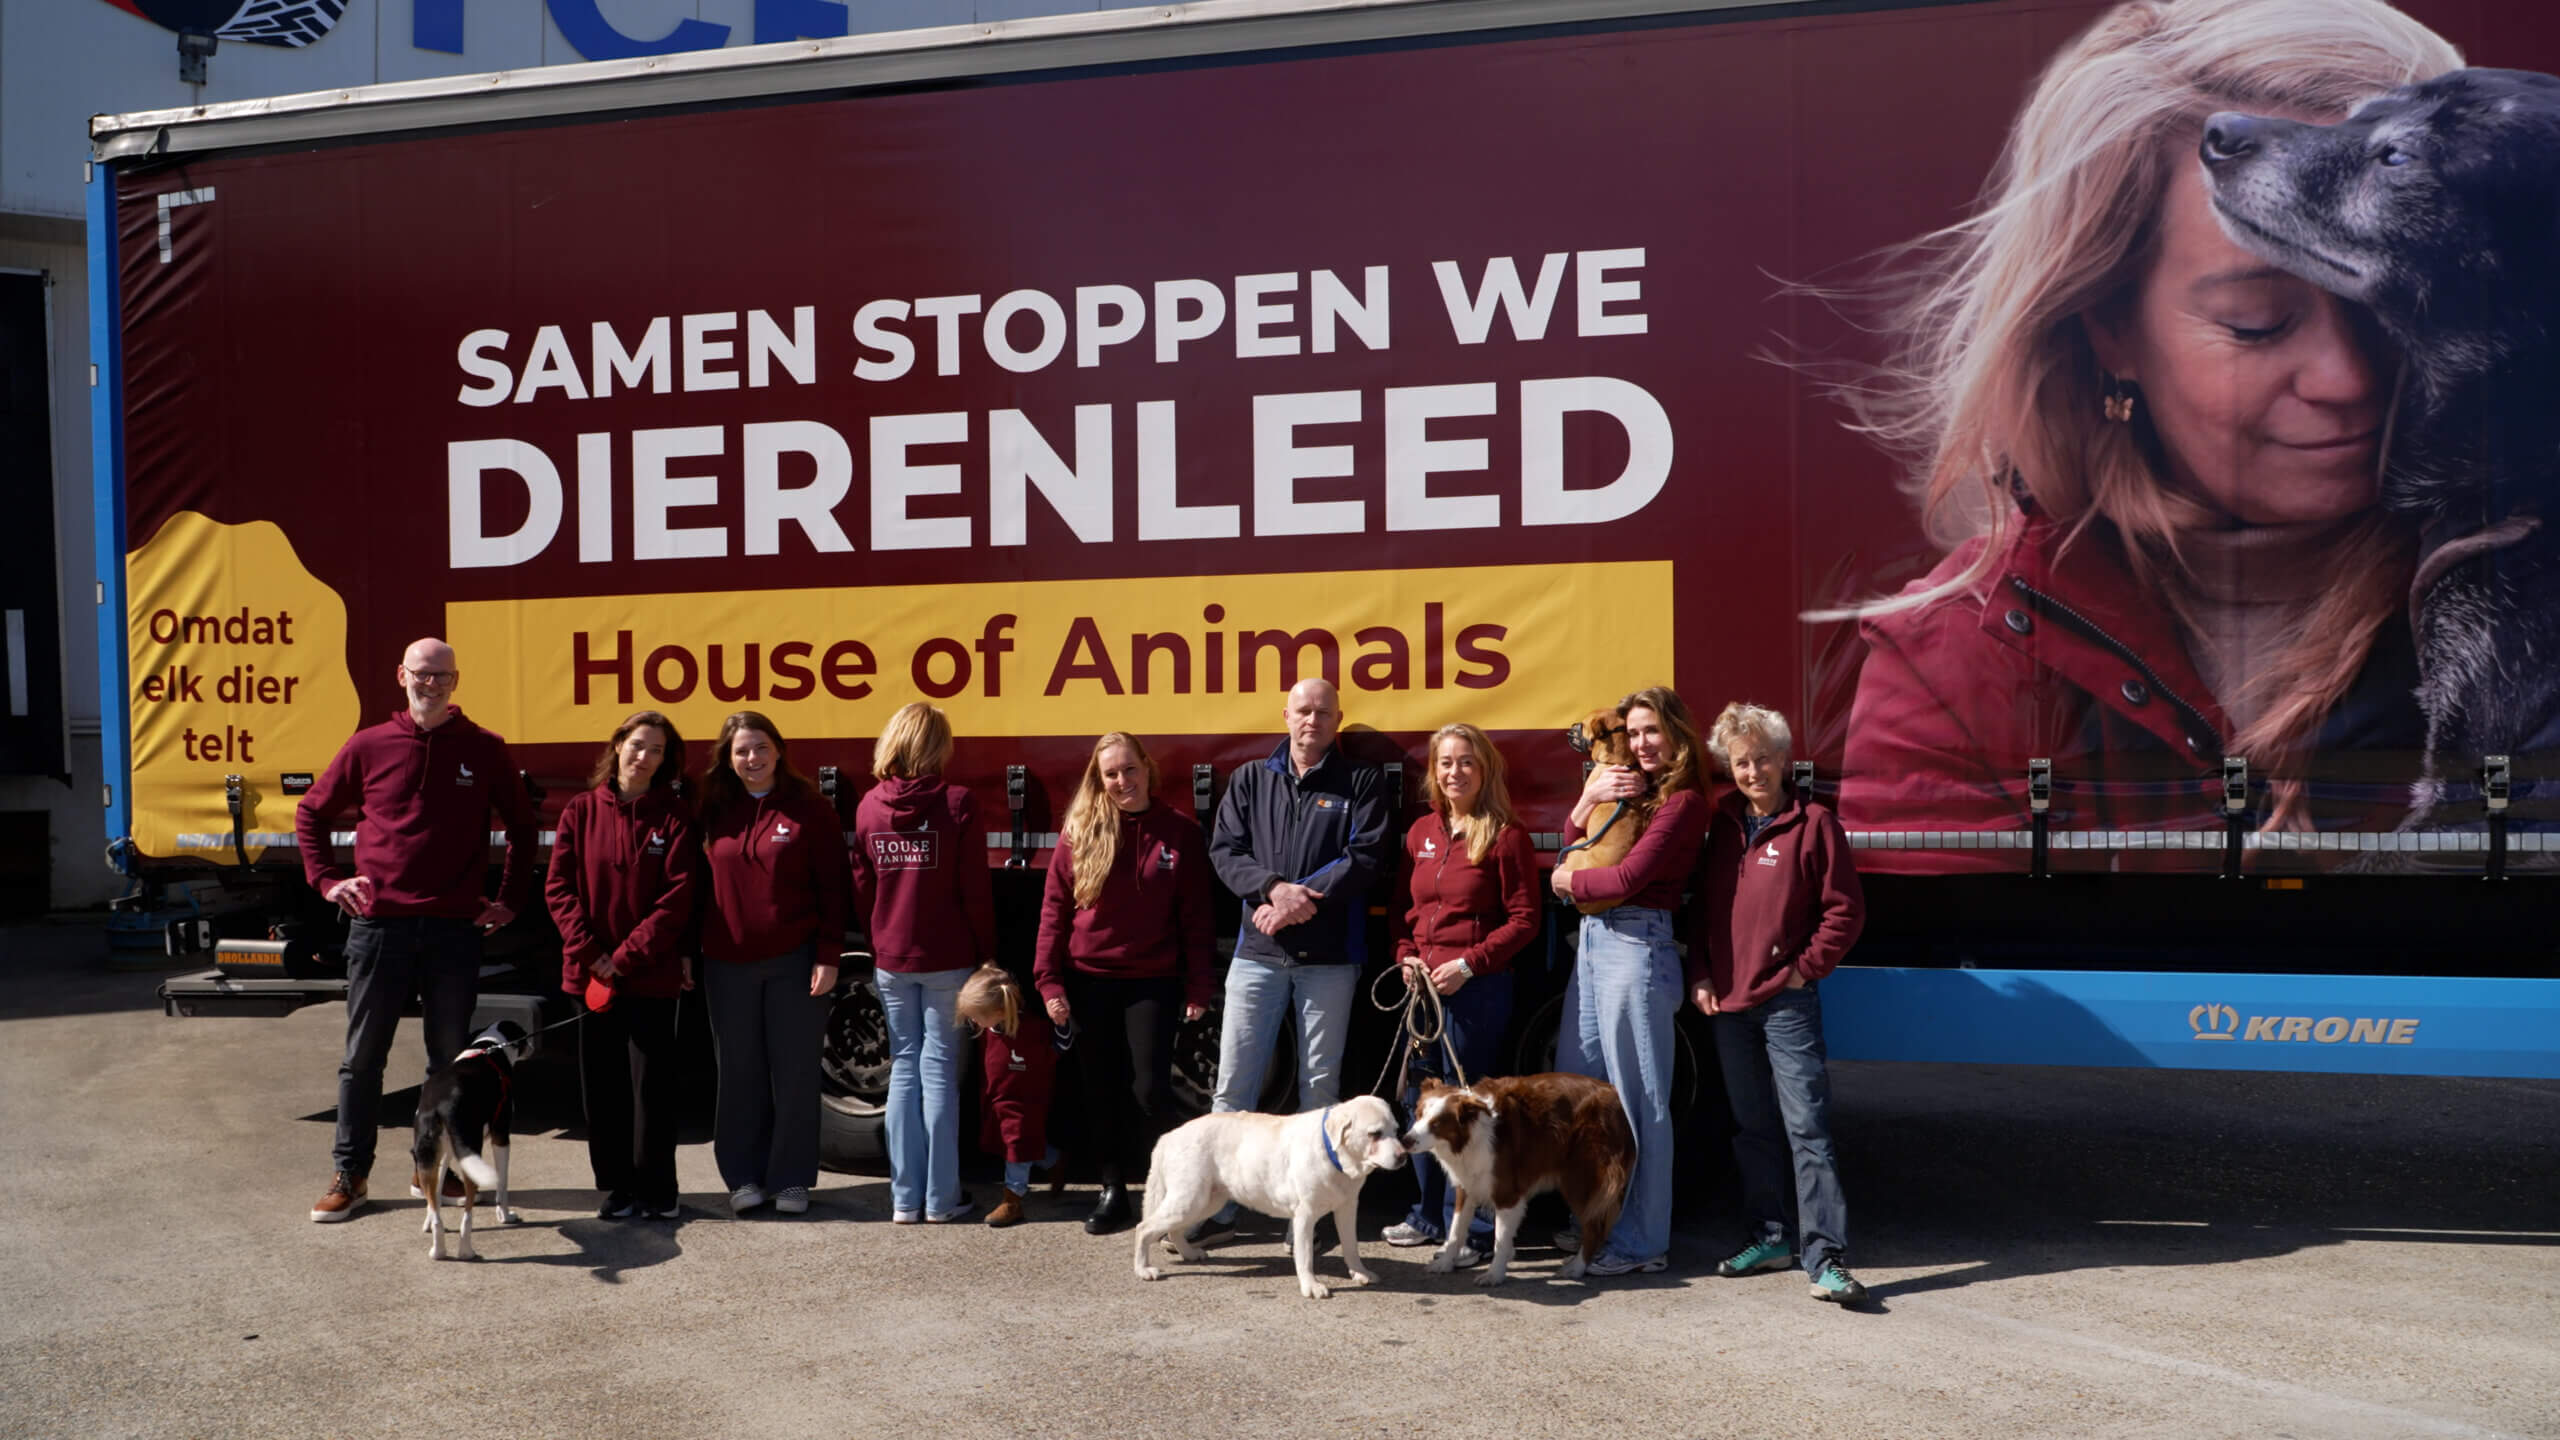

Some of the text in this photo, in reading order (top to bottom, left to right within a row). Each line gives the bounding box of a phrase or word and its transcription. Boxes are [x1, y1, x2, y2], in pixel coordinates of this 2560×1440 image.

[458, 247, 1648, 407] SAMEN STOPPEN WE
[447, 376, 1674, 569] DIERENLEED
[149, 606, 294, 645] Omdat
[573, 602, 1511, 706] House of Animals
[142, 664, 299, 704] elk dier
[182, 725, 255, 763] telt
[874, 840, 930, 854] HOUSE
[216, 951, 281, 965] DHOLLANDIA
[2243, 1015, 2420, 1044] KRONE
